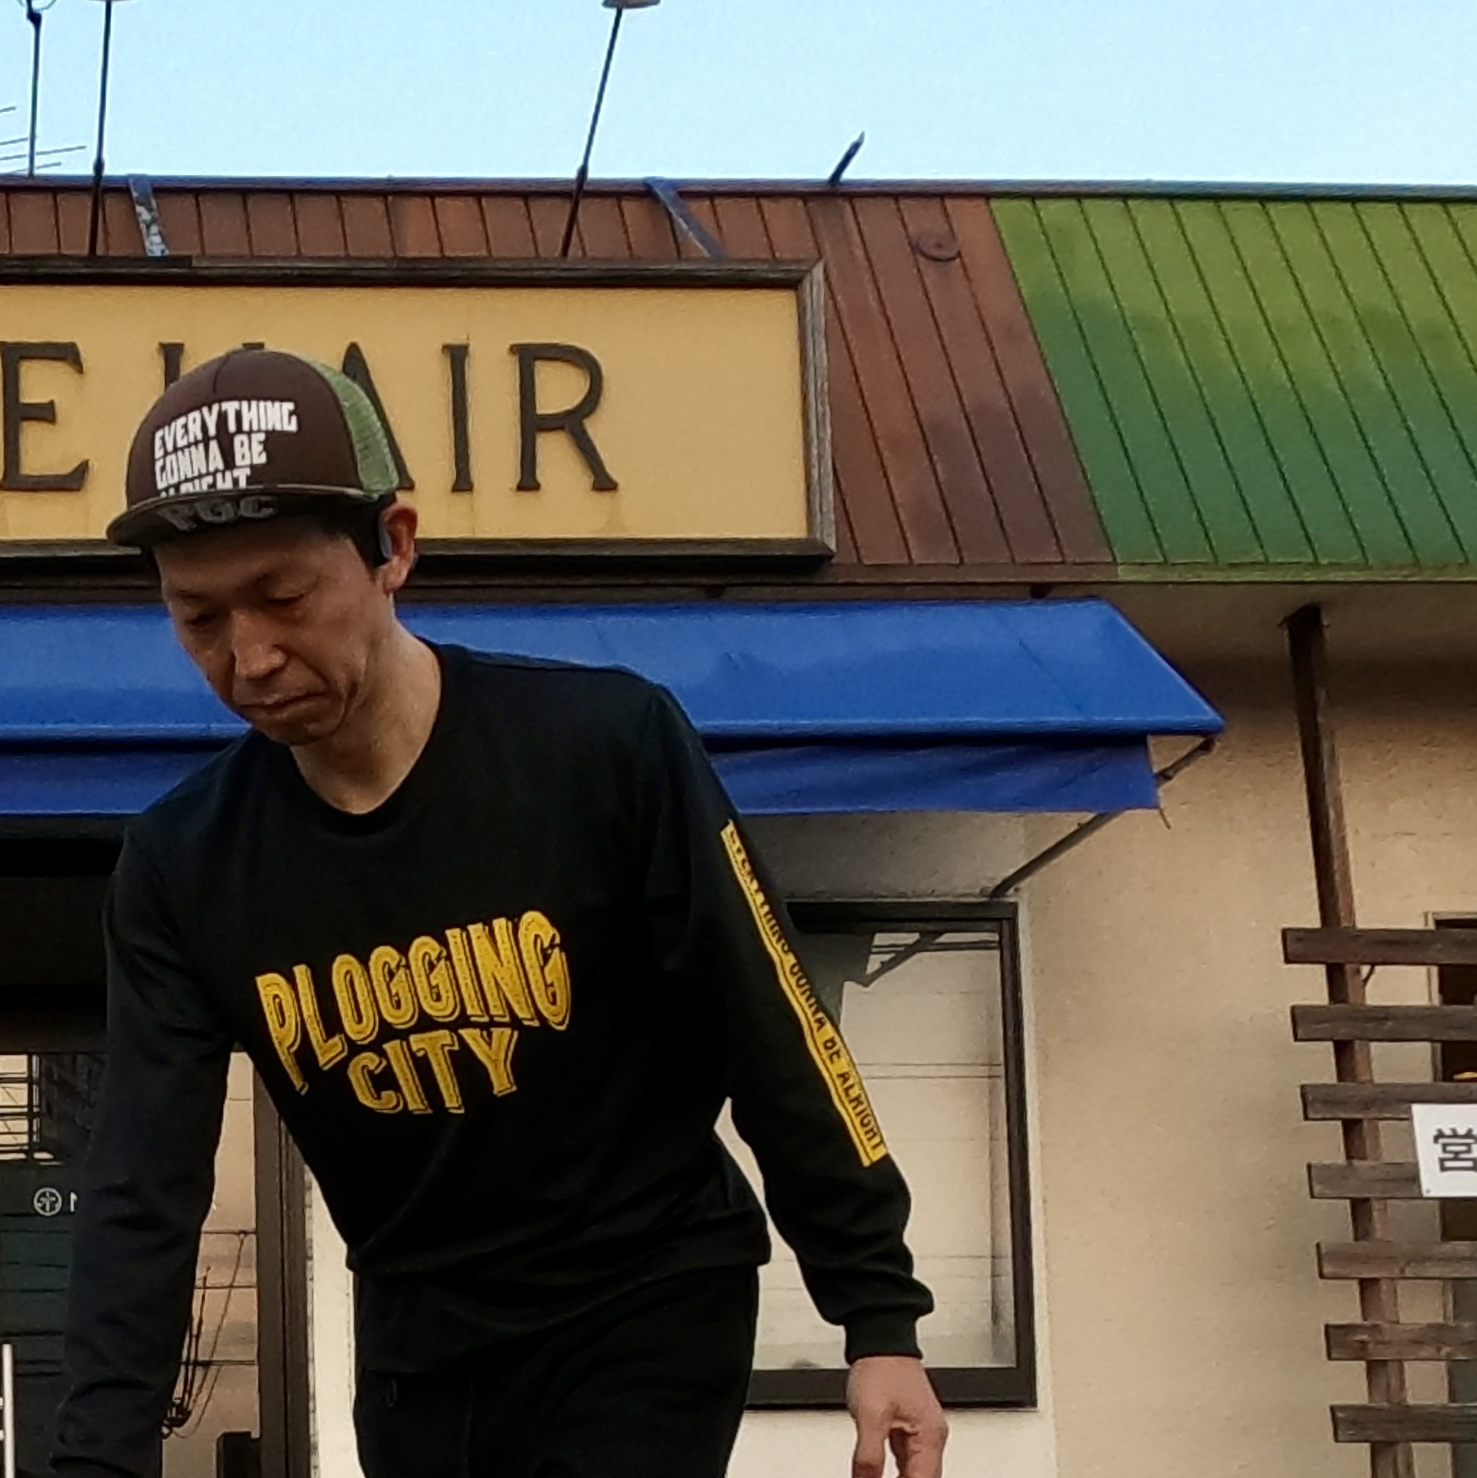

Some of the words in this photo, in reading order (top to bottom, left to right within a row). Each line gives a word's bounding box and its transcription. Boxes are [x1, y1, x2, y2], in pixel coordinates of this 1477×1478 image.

[153, 400, 298, 460] EVERYTHING
[154, 439, 224, 490] GONNA
[233, 432, 268, 467] BE
[158, 341, 619, 494] AIR
[255, 910, 573, 1097] PLOGGING
[347, 1026, 519, 1115] CITY
